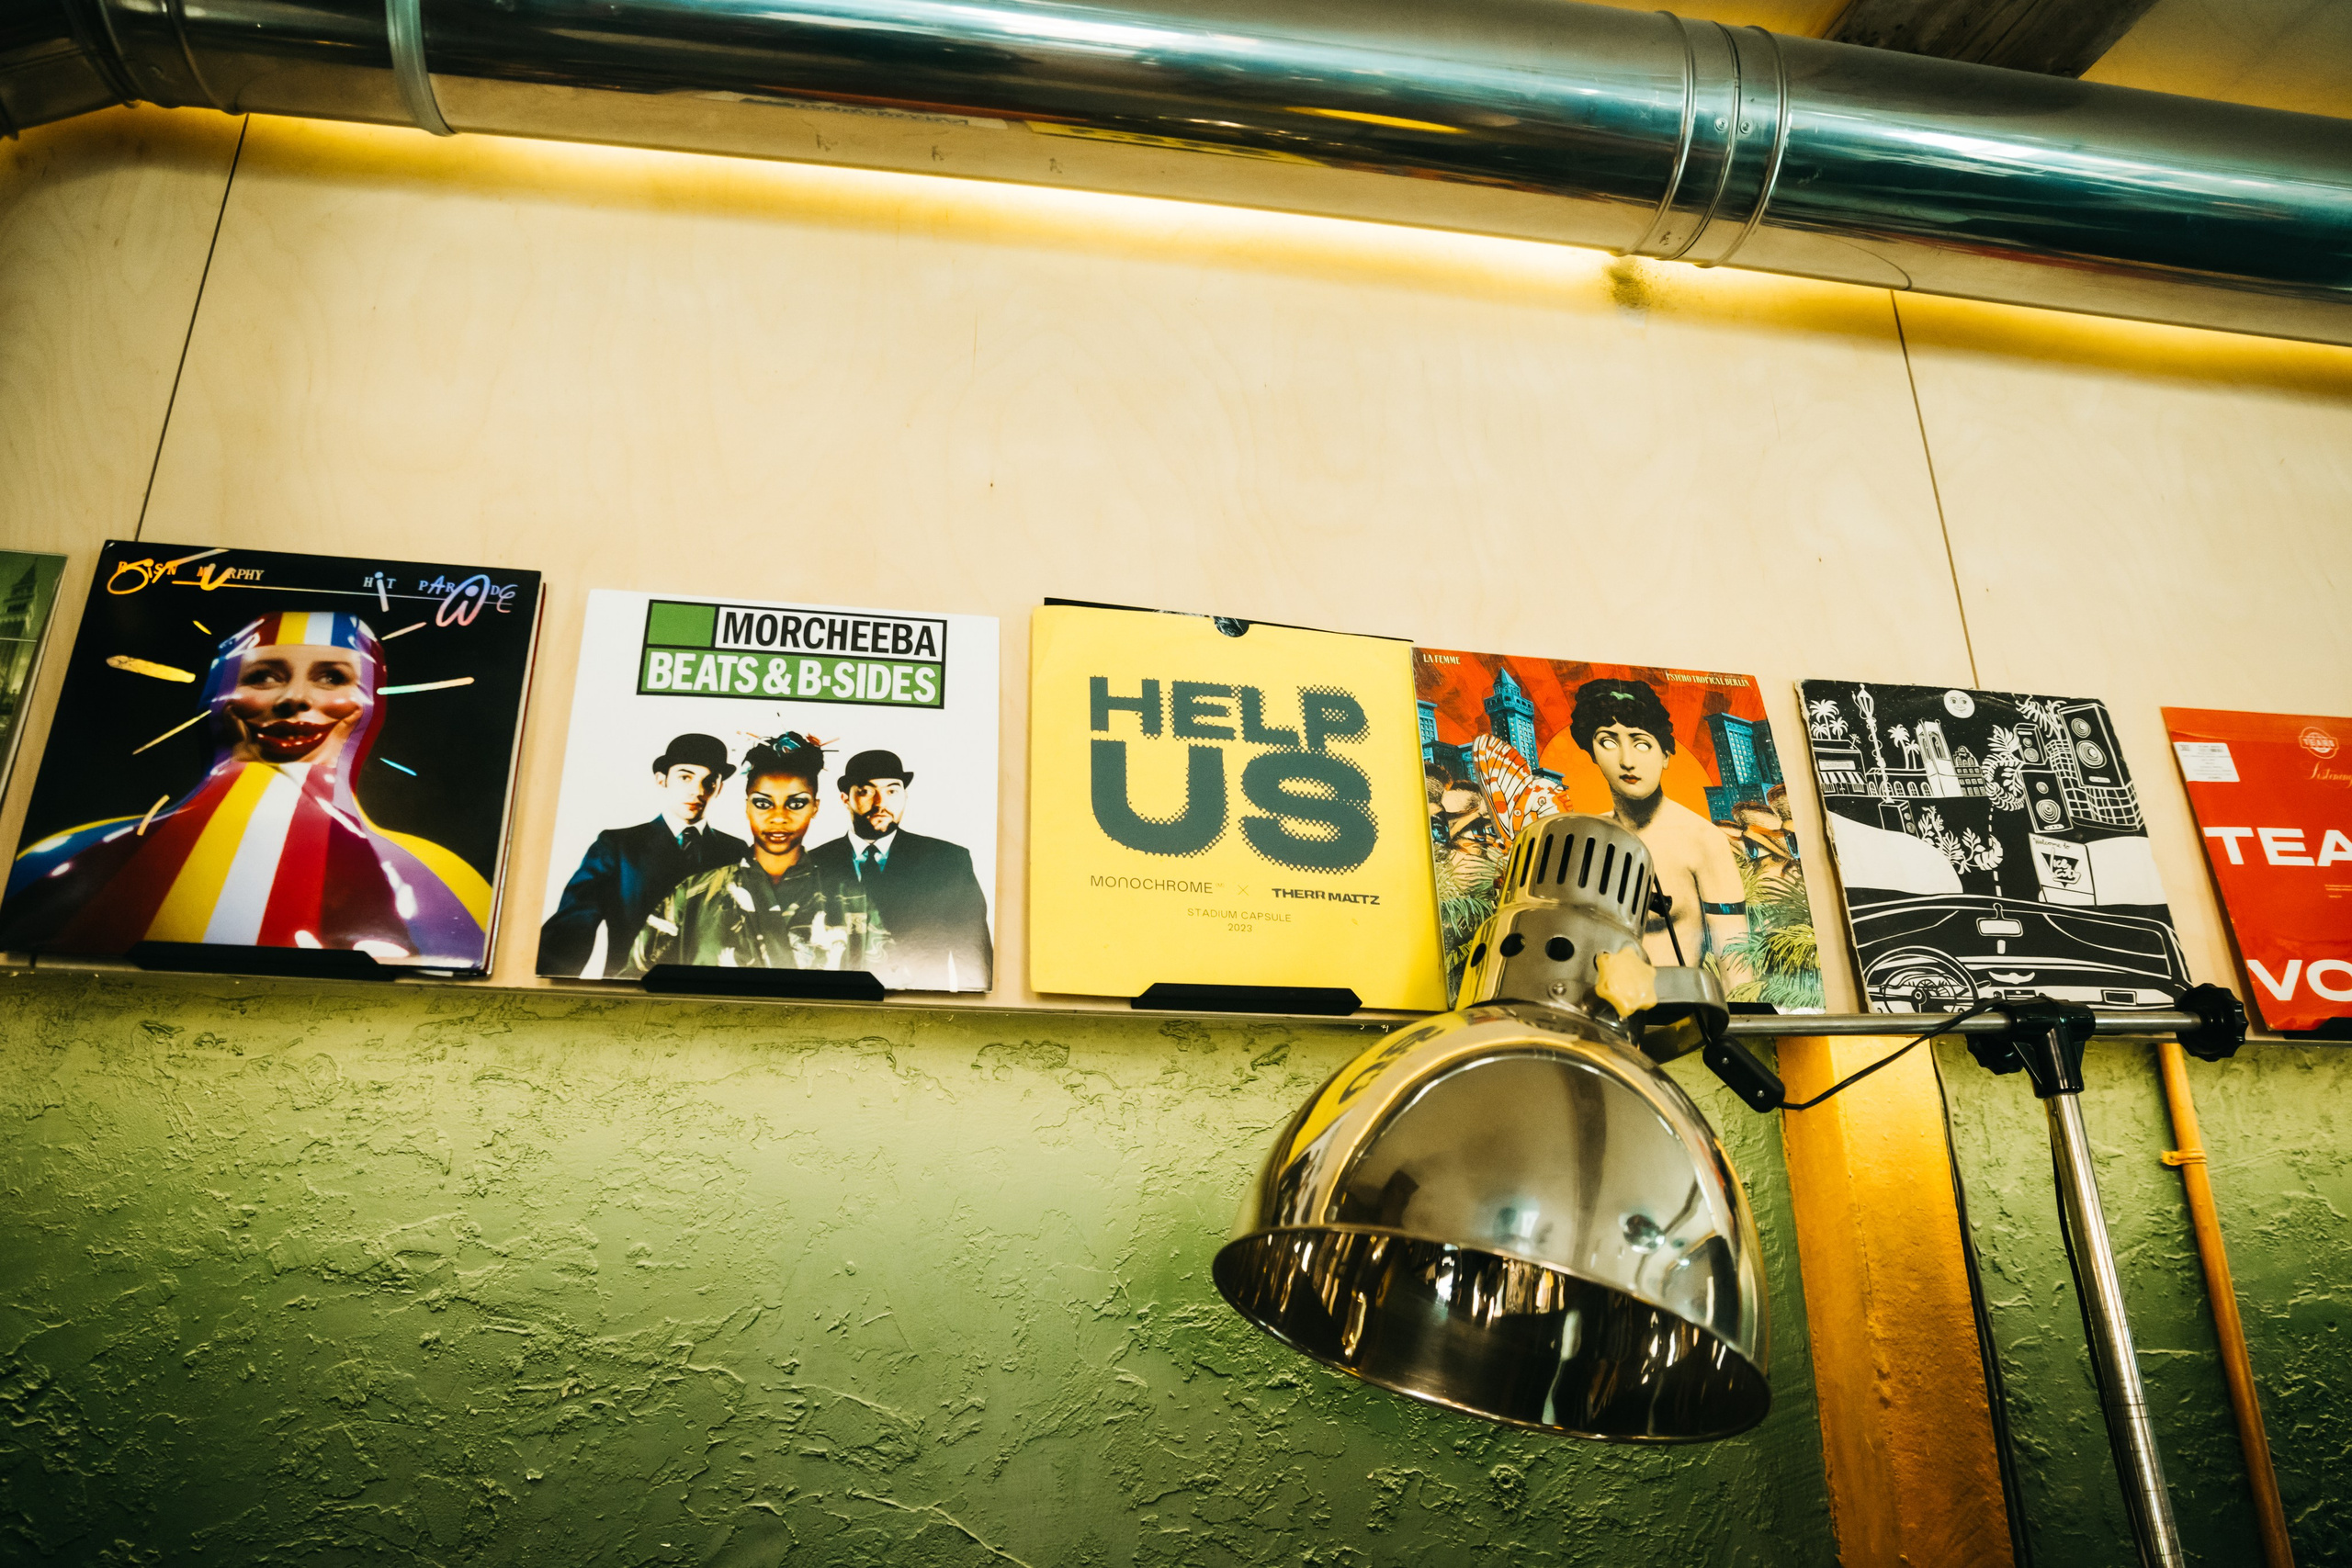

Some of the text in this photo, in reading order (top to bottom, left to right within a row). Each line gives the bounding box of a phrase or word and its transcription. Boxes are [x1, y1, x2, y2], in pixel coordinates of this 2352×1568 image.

[721, 611, 937, 657] MORCHEEBA
[1422, 653, 1461, 665] LA FEMME
[646, 651, 760, 694] BEATS
[763, 657, 793, 695] &
[1665, 671, 1749, 687] PSYCHO TROPICAL BERLIN
[1090, 674, 1370, 751] HELP
[1091, 738, 1379, 875] US
[1272, 887, 1327, 900] THERR
[1328, 894, 1381, 906] MAITZ
[1186, 908, 1292, 923] STADIUM CAPSULE
[1227, 923, 1253, 933] 2023
